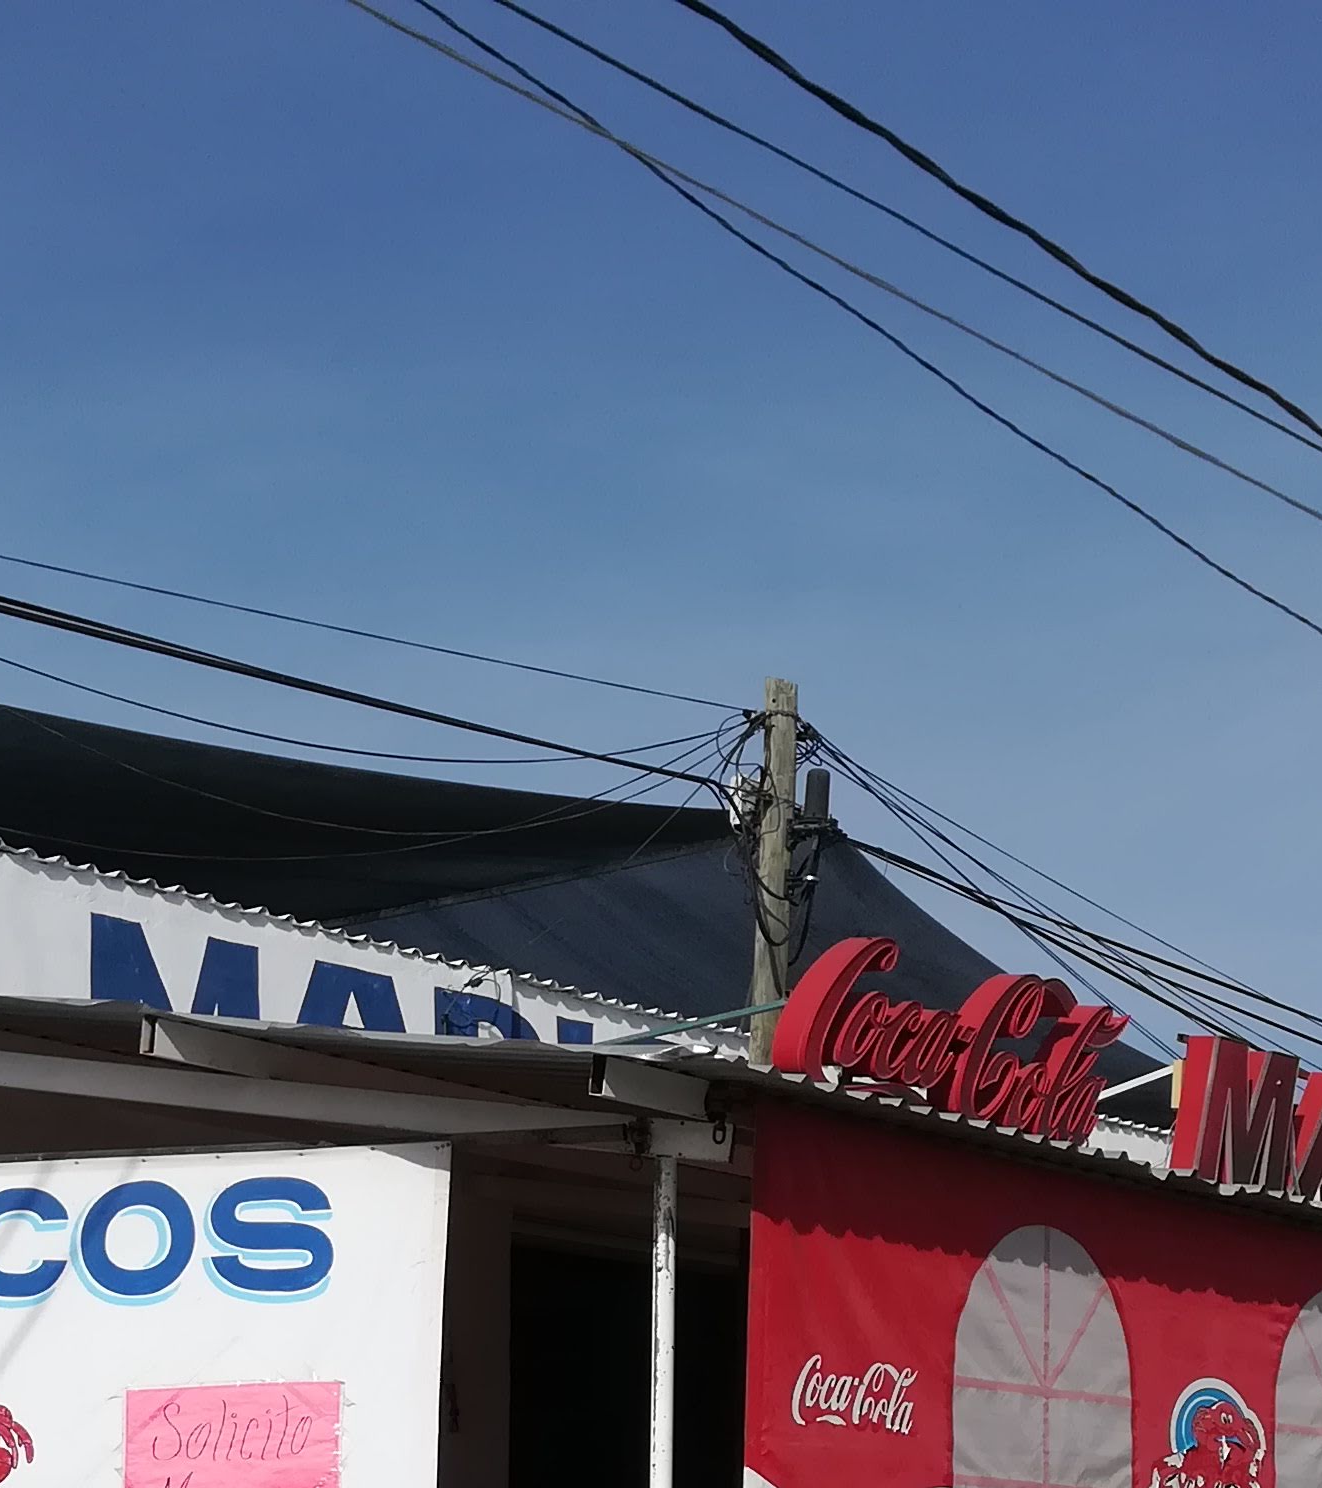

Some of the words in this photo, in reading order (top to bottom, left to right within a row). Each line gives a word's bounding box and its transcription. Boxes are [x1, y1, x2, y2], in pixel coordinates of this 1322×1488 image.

[772, 936, 1130, 1146] Coca-Cola
[152, 1395, 313, 1461] Solicito
[792, 1354, 918, 1435] Coca-Cola
